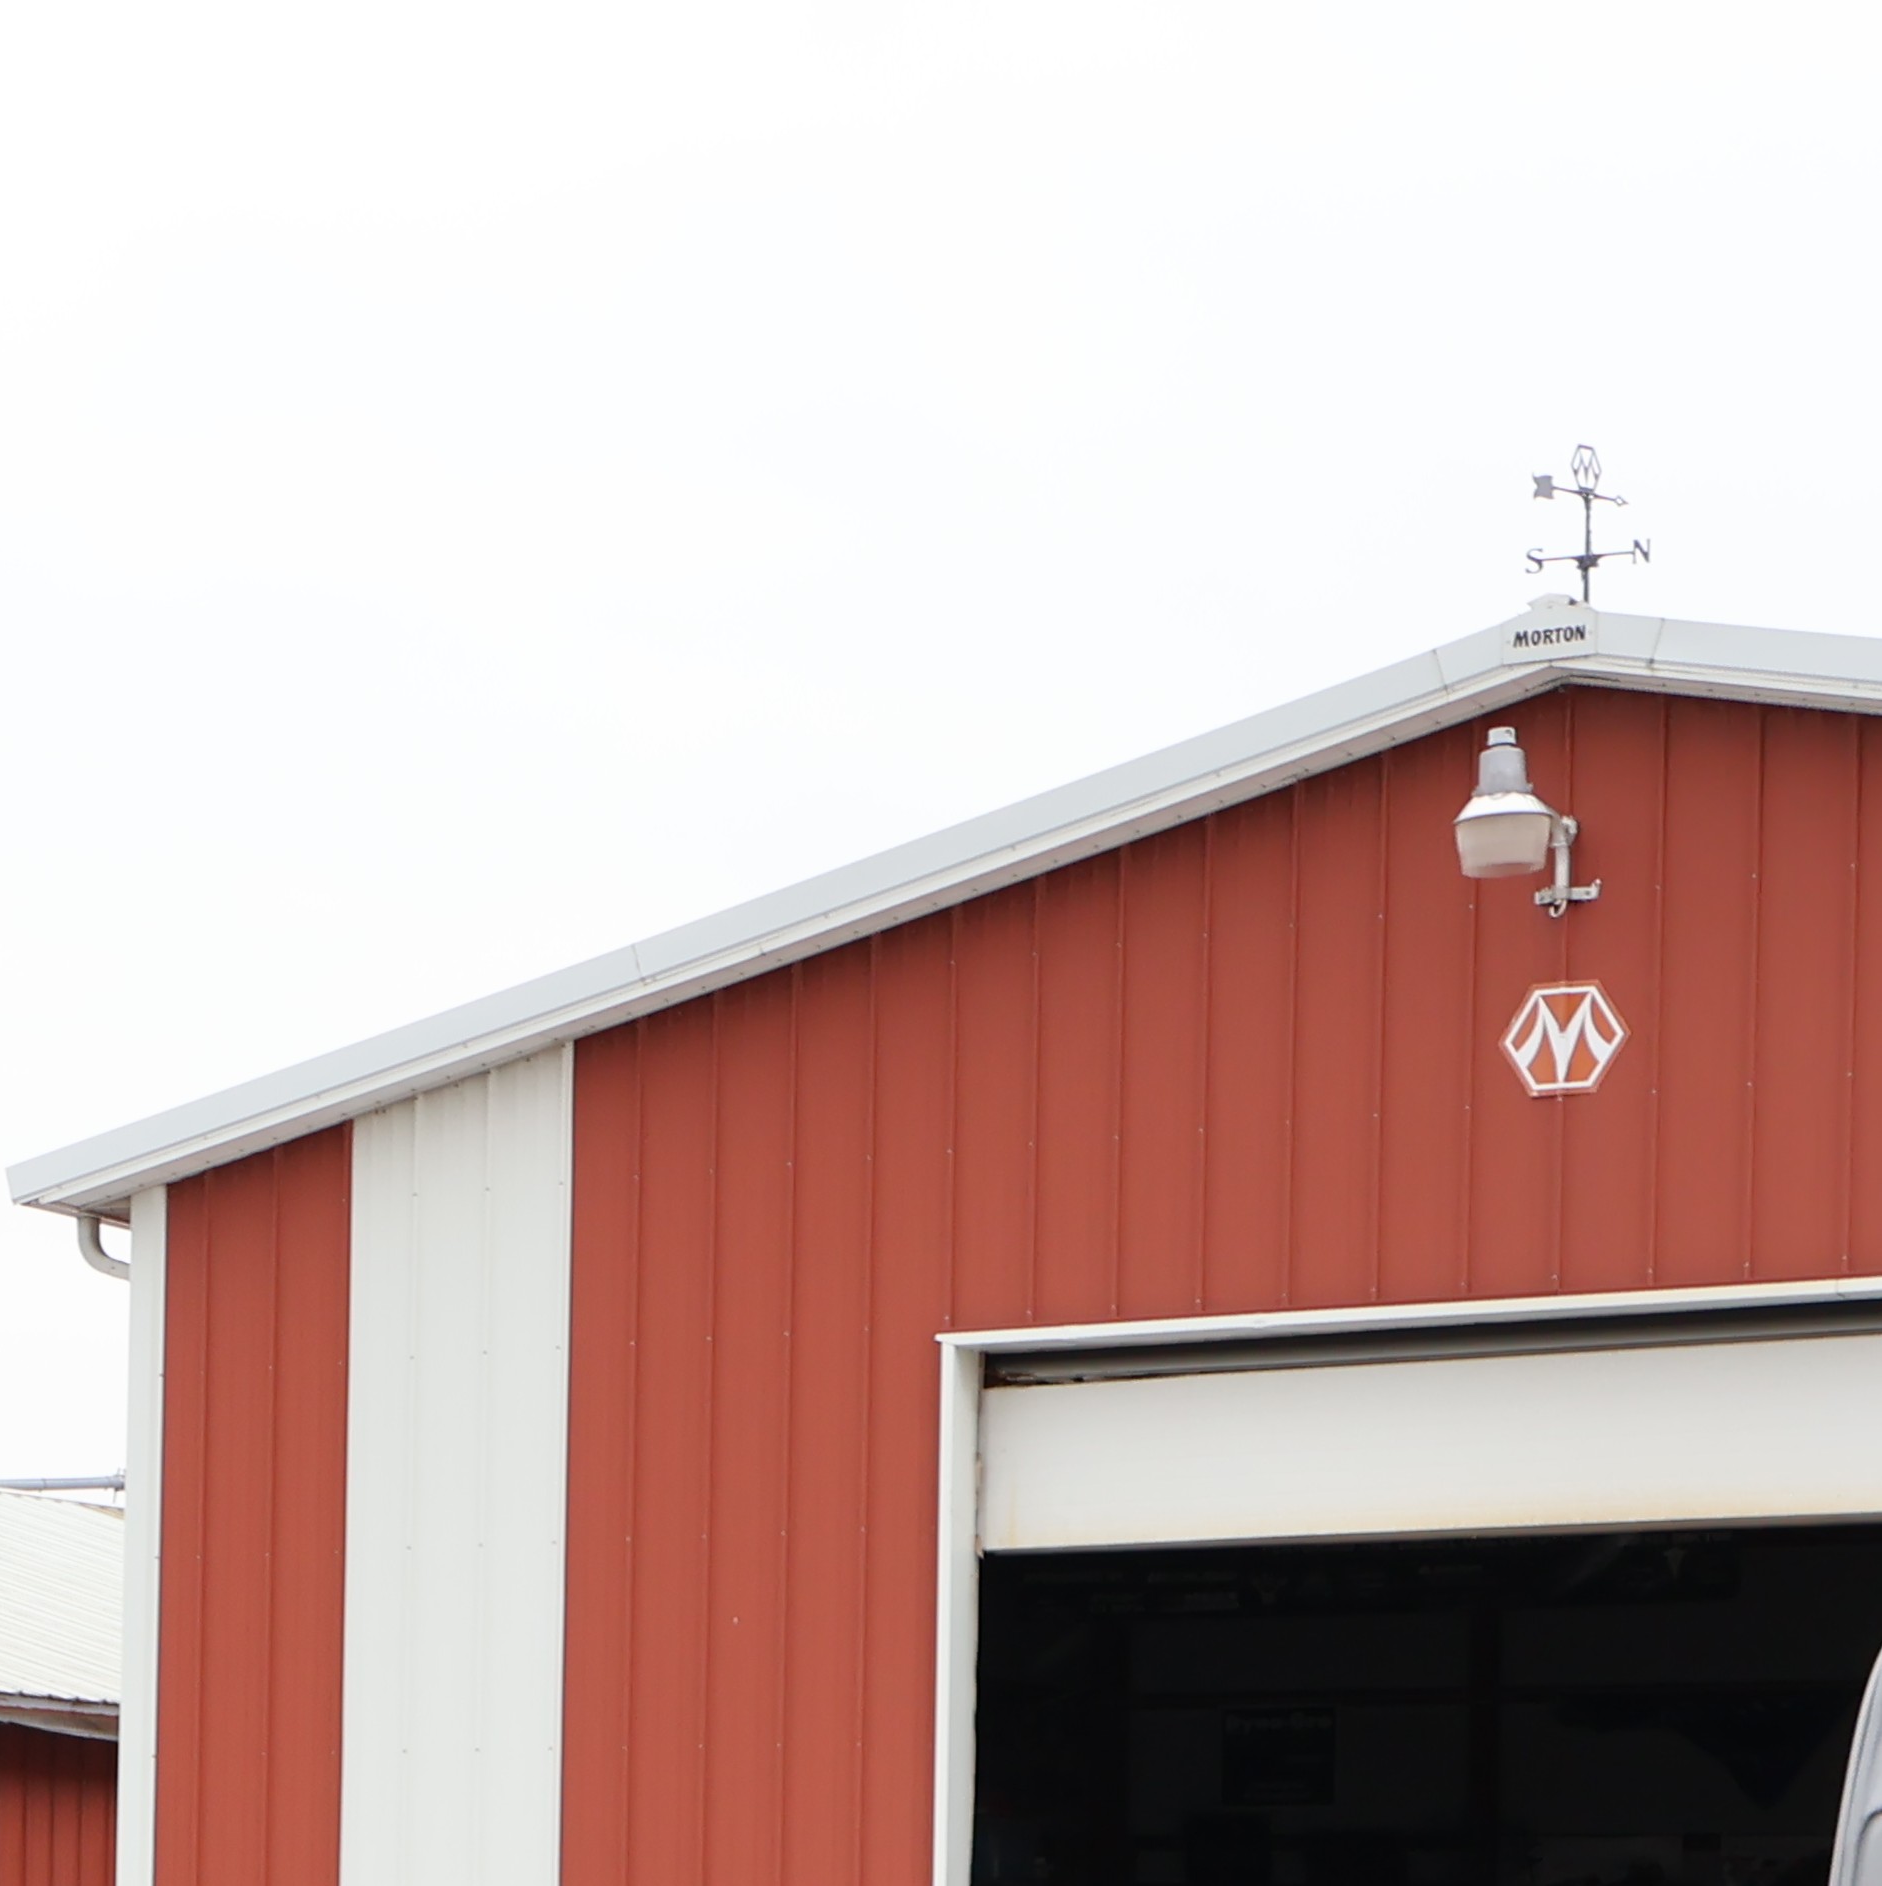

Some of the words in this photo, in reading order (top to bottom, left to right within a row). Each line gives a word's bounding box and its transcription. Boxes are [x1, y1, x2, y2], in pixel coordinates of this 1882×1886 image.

[1525, 549, 1544, 574] S
[1632, 539, 1650, 564] N
[1513, 624, 1585, 648] MORTON
